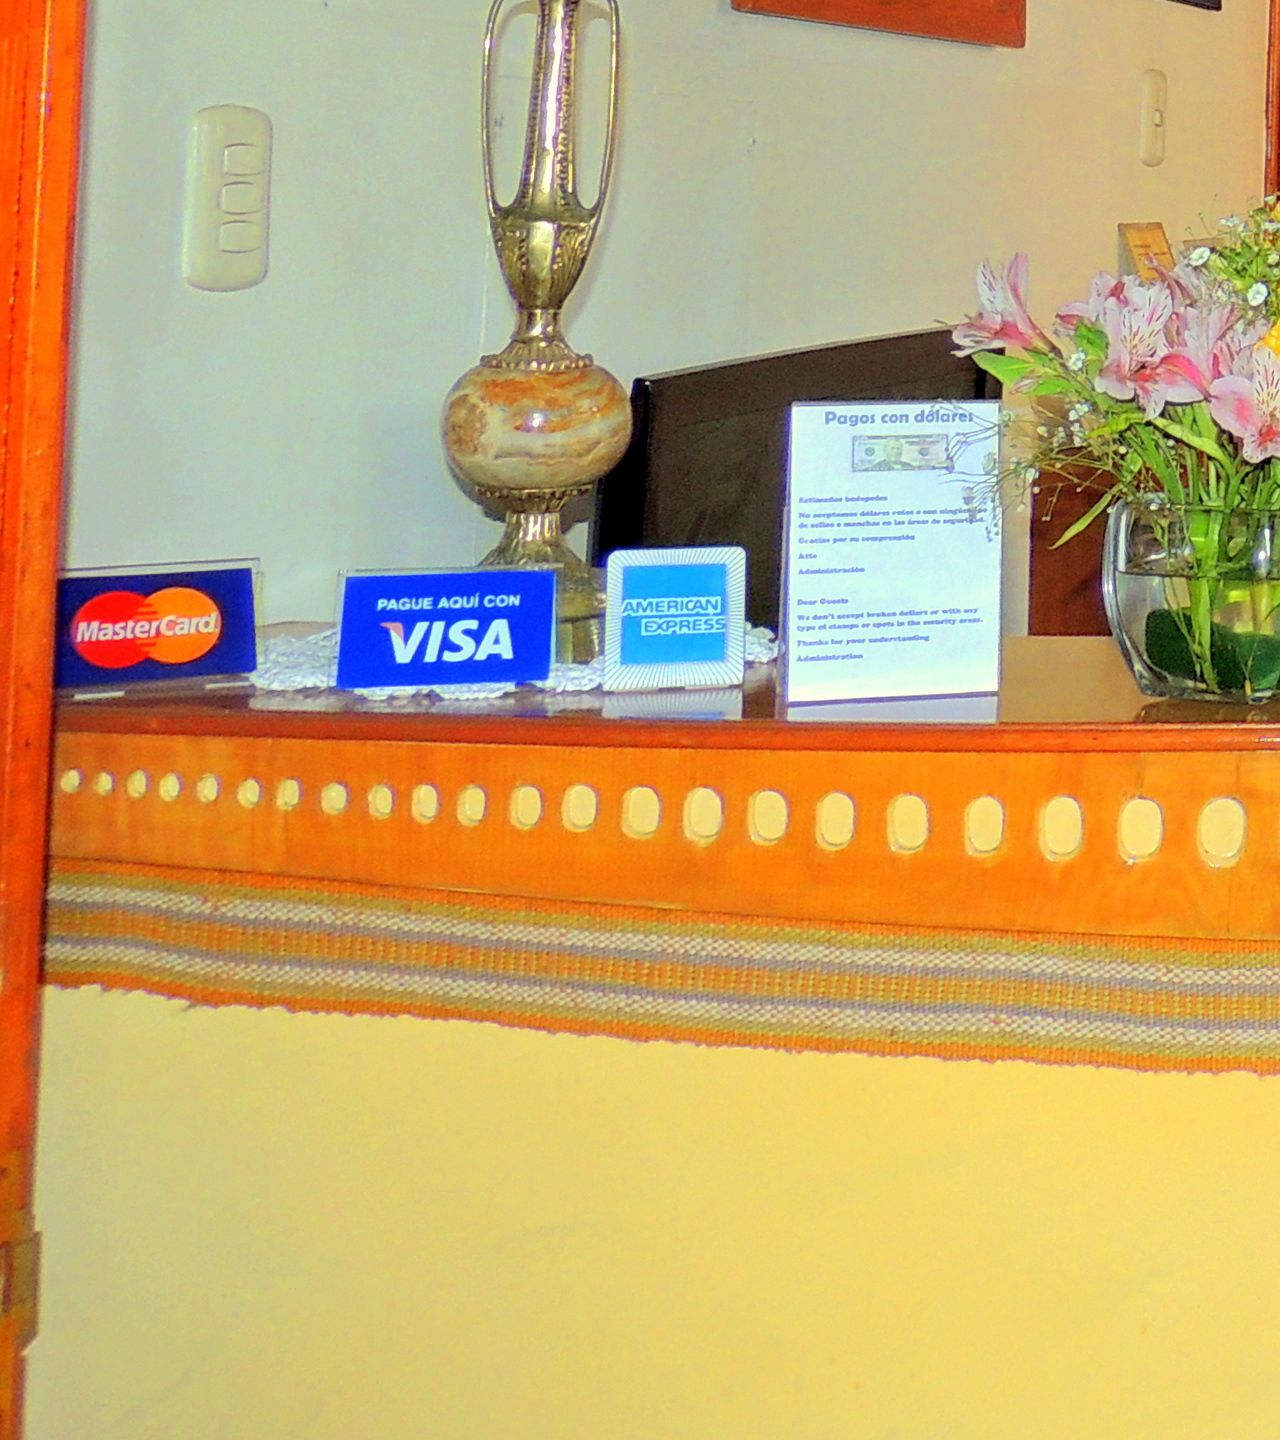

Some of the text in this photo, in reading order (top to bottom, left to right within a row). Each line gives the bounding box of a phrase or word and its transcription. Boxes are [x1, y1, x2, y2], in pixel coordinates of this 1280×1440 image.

[824, 410, 973, 426] Pagos con dólares
[377, 594, 520, 610] PAGUE AQUÍ CON
[623, 596, 720, 615] AMERICAN
[75, 613, 217, 643] MasterCard
[641, 616, 725, 635] EXPRESS
[380, 619, 513, 664] VISA
